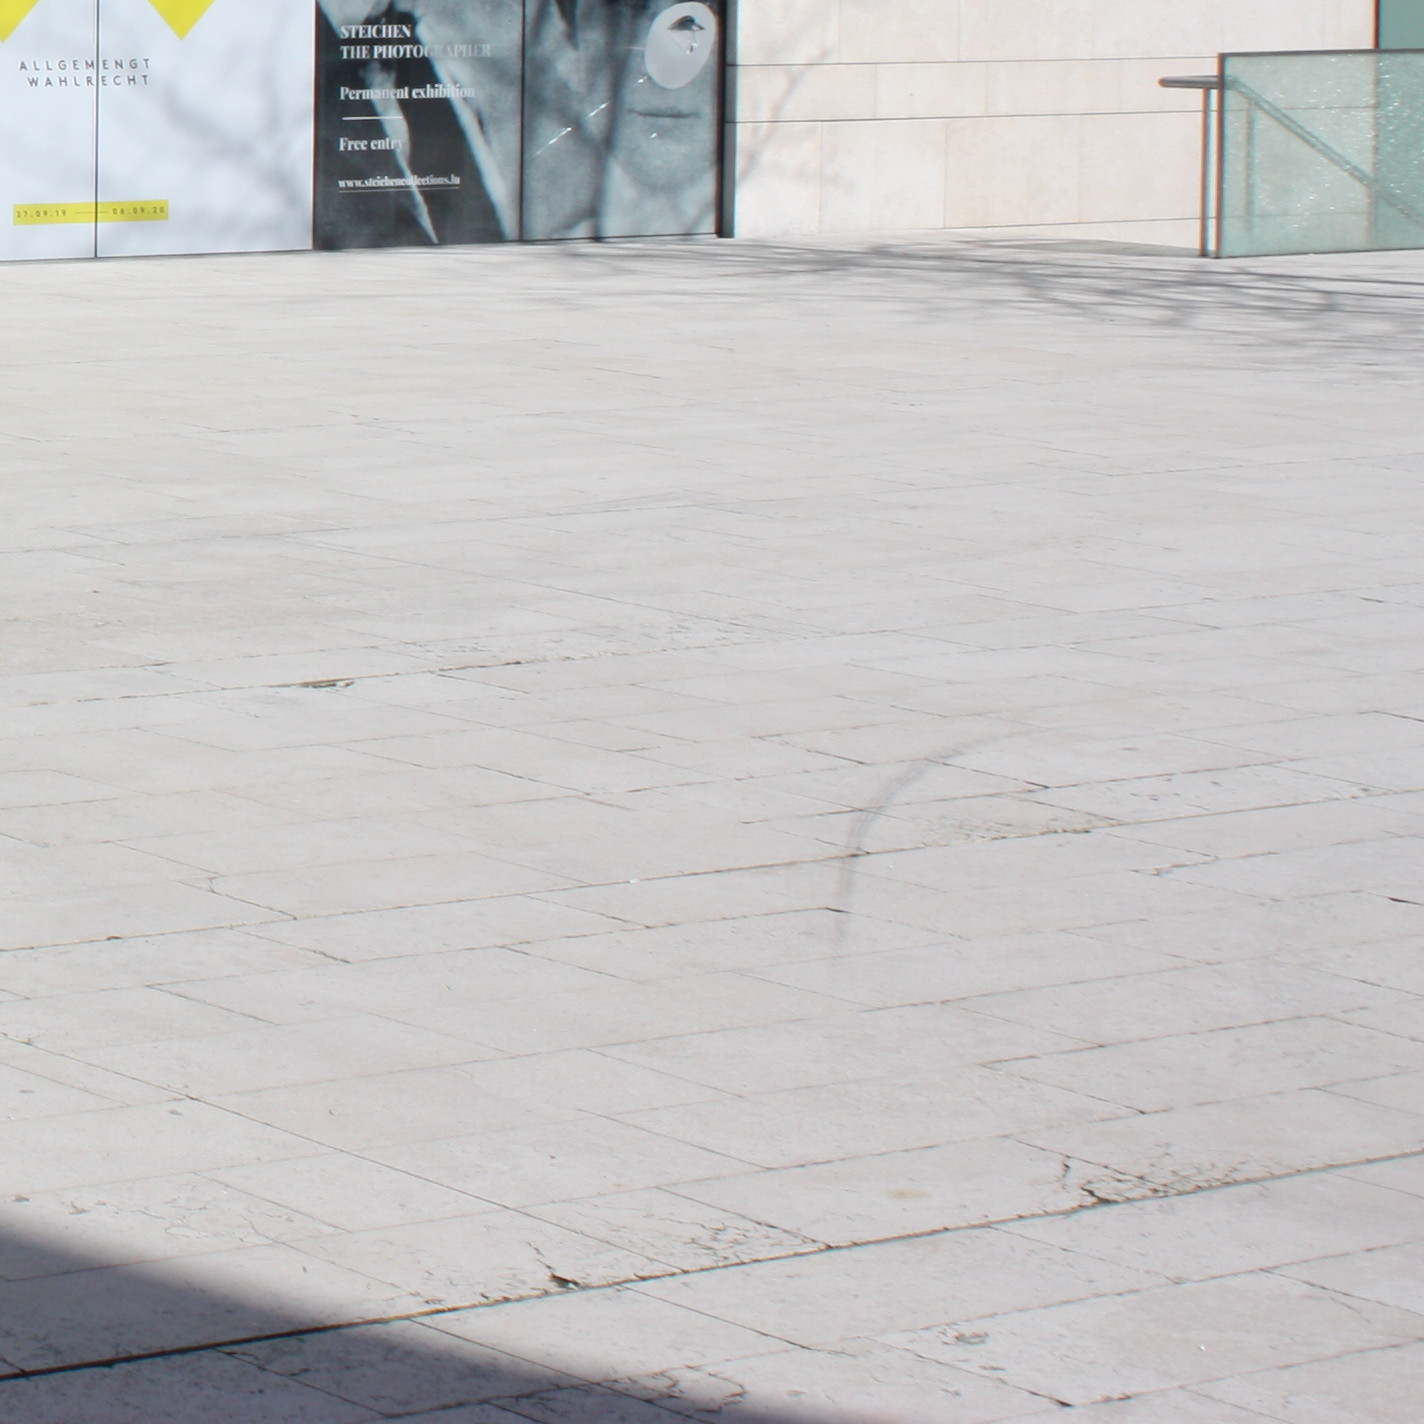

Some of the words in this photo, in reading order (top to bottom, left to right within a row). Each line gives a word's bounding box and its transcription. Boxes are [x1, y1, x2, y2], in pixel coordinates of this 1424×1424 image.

[340, 24, 412, 39] STEICHEN
[339, 45, 370, 60] THE
[373, 43, 491, 59] PHOTOGRAPHER
[18, 57, 152, 72] ALLGEMENGT
[27, 73, 151, 88] WAHLRECHT
[339, 85, 409, 100] Permanent
[411, 83, 476, 99] exhibition
[338, 137, 368, 151] Free
[370, 137, 404, 153] entry
